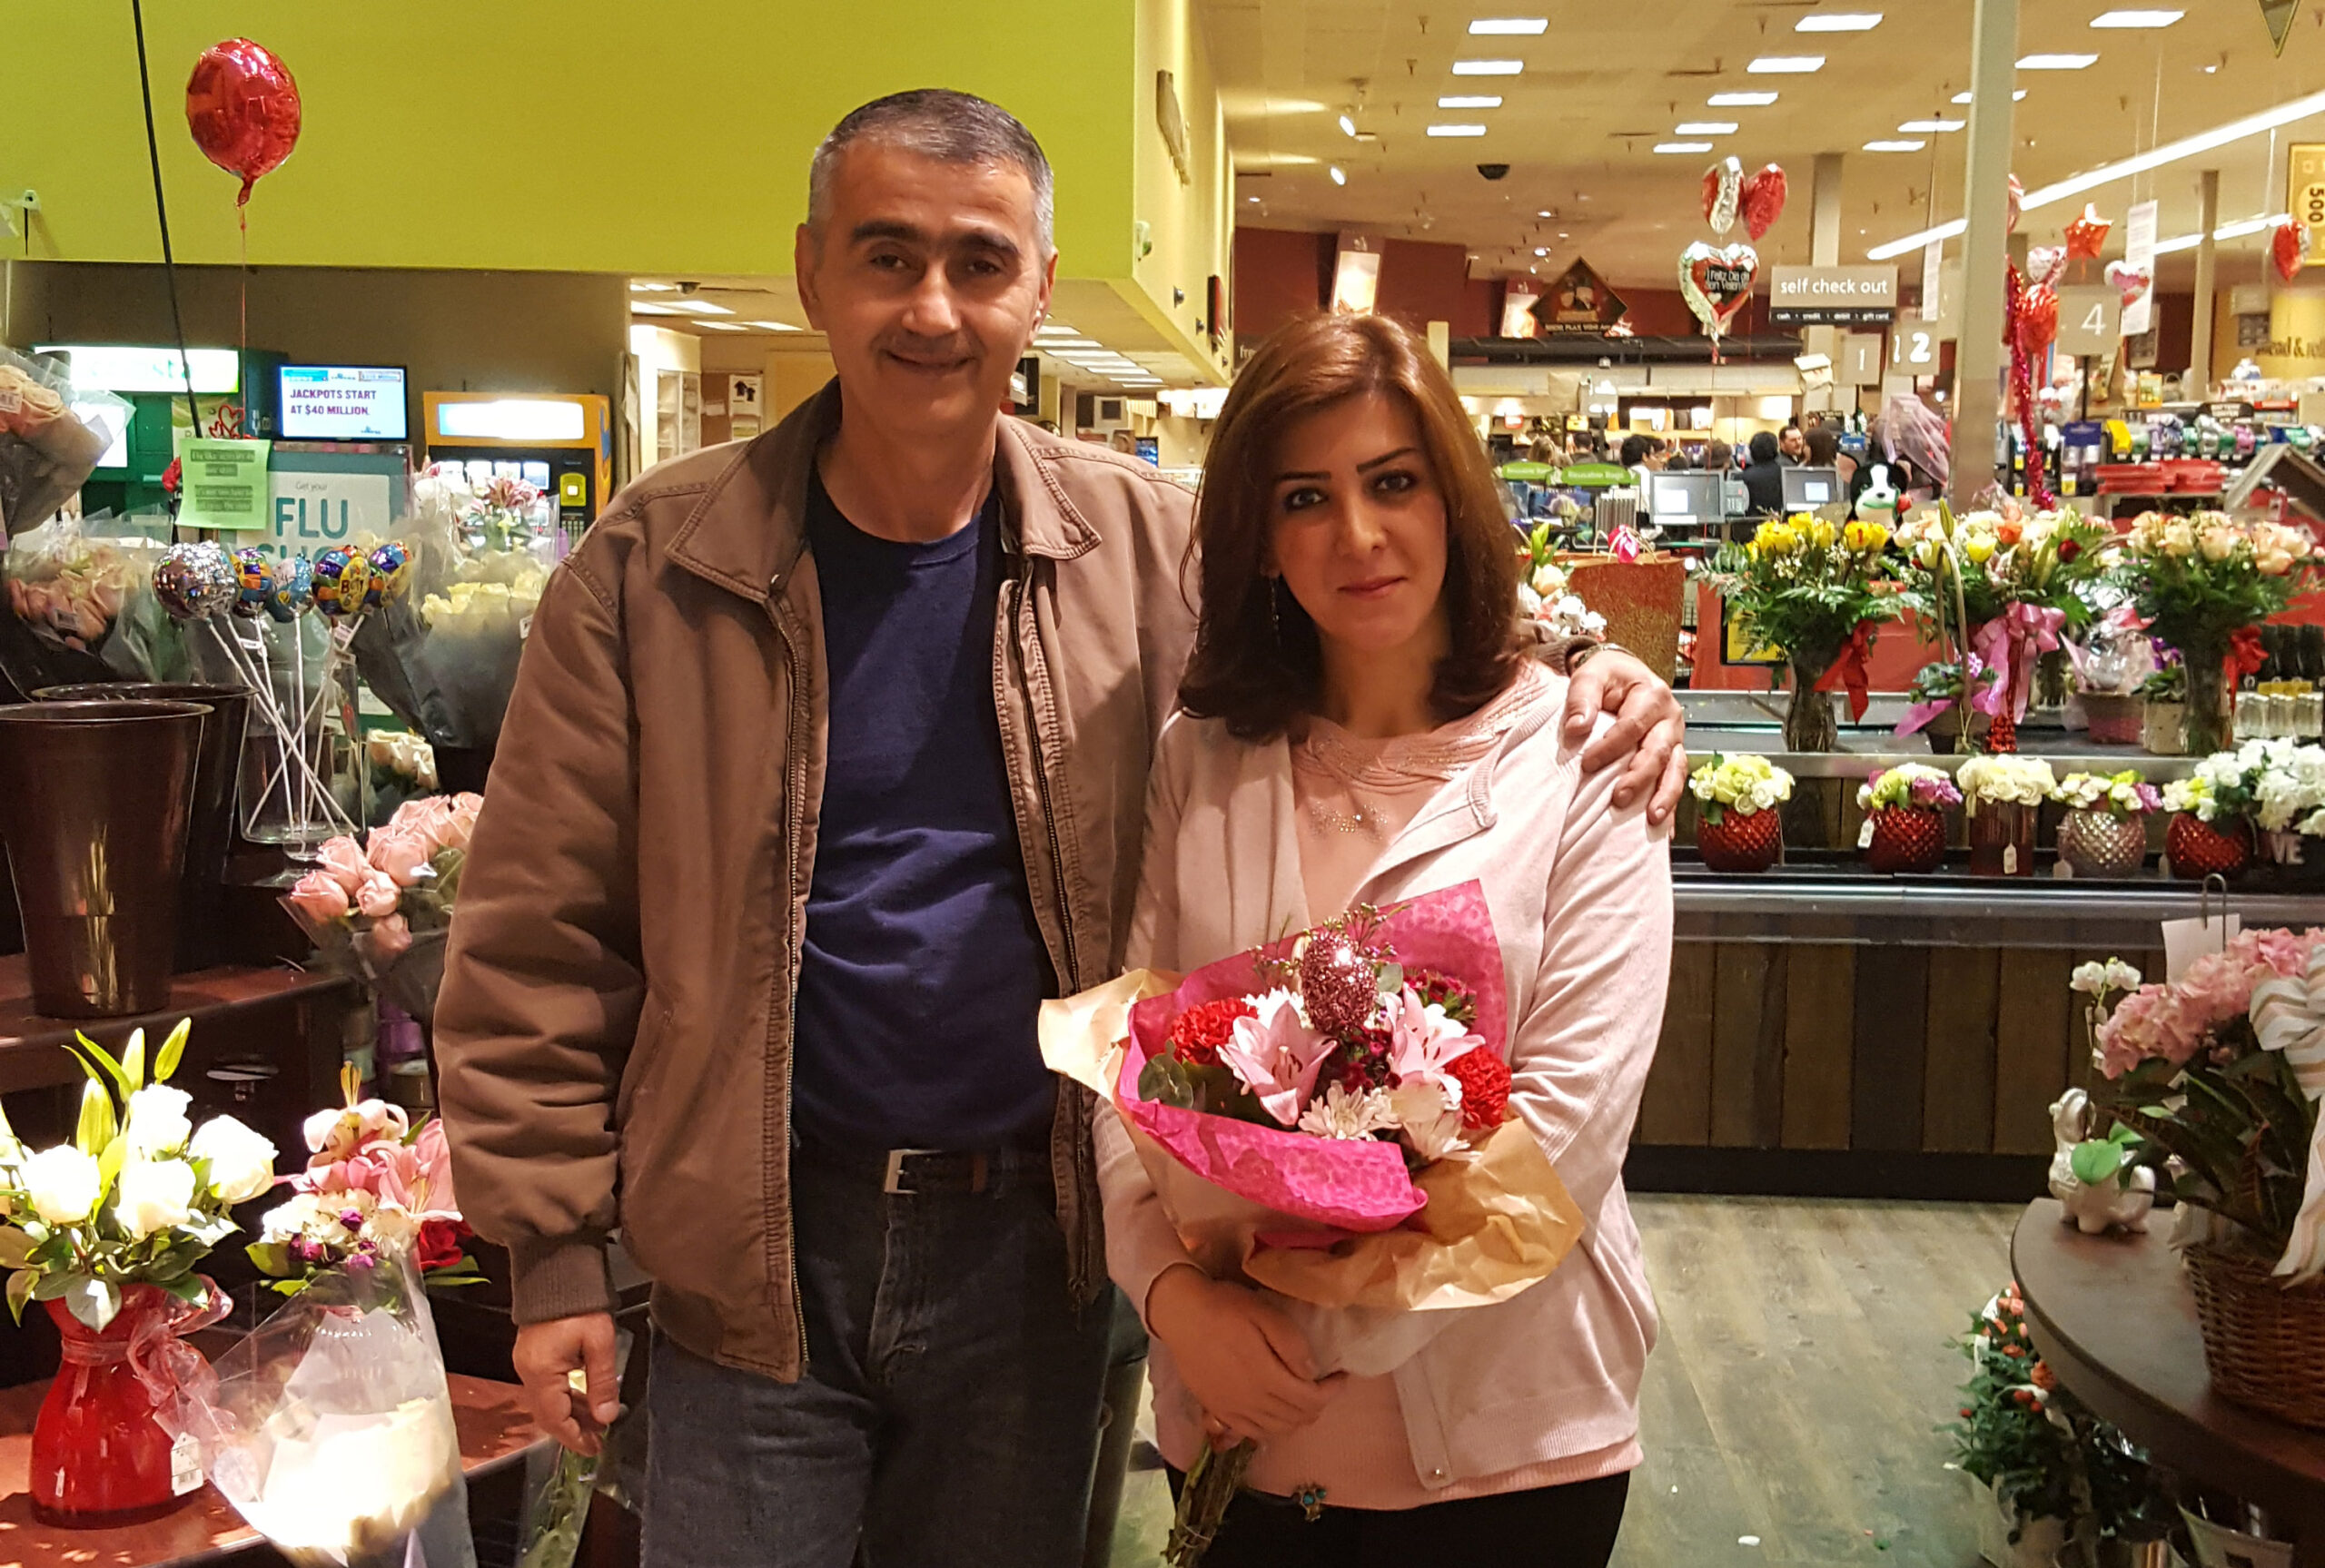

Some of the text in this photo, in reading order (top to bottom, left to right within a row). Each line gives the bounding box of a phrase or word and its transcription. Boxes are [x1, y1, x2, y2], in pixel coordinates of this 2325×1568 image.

[2308, 187, 2325, 222] 500
[1780, 277, 1888, 294] self check out
[2081, 302, 2106, 336] 4
[1909, 331, 1932, 363] 2
[1859, 348, 1865, 371] 1
[290, 389, 377, 399] JACKPOTS START
[291, 405, 302, 414] AT
[305, 404, 324, 415] $40
[295, 481, 328, 493] Get your
[275, 497, 349, 539] FLU
